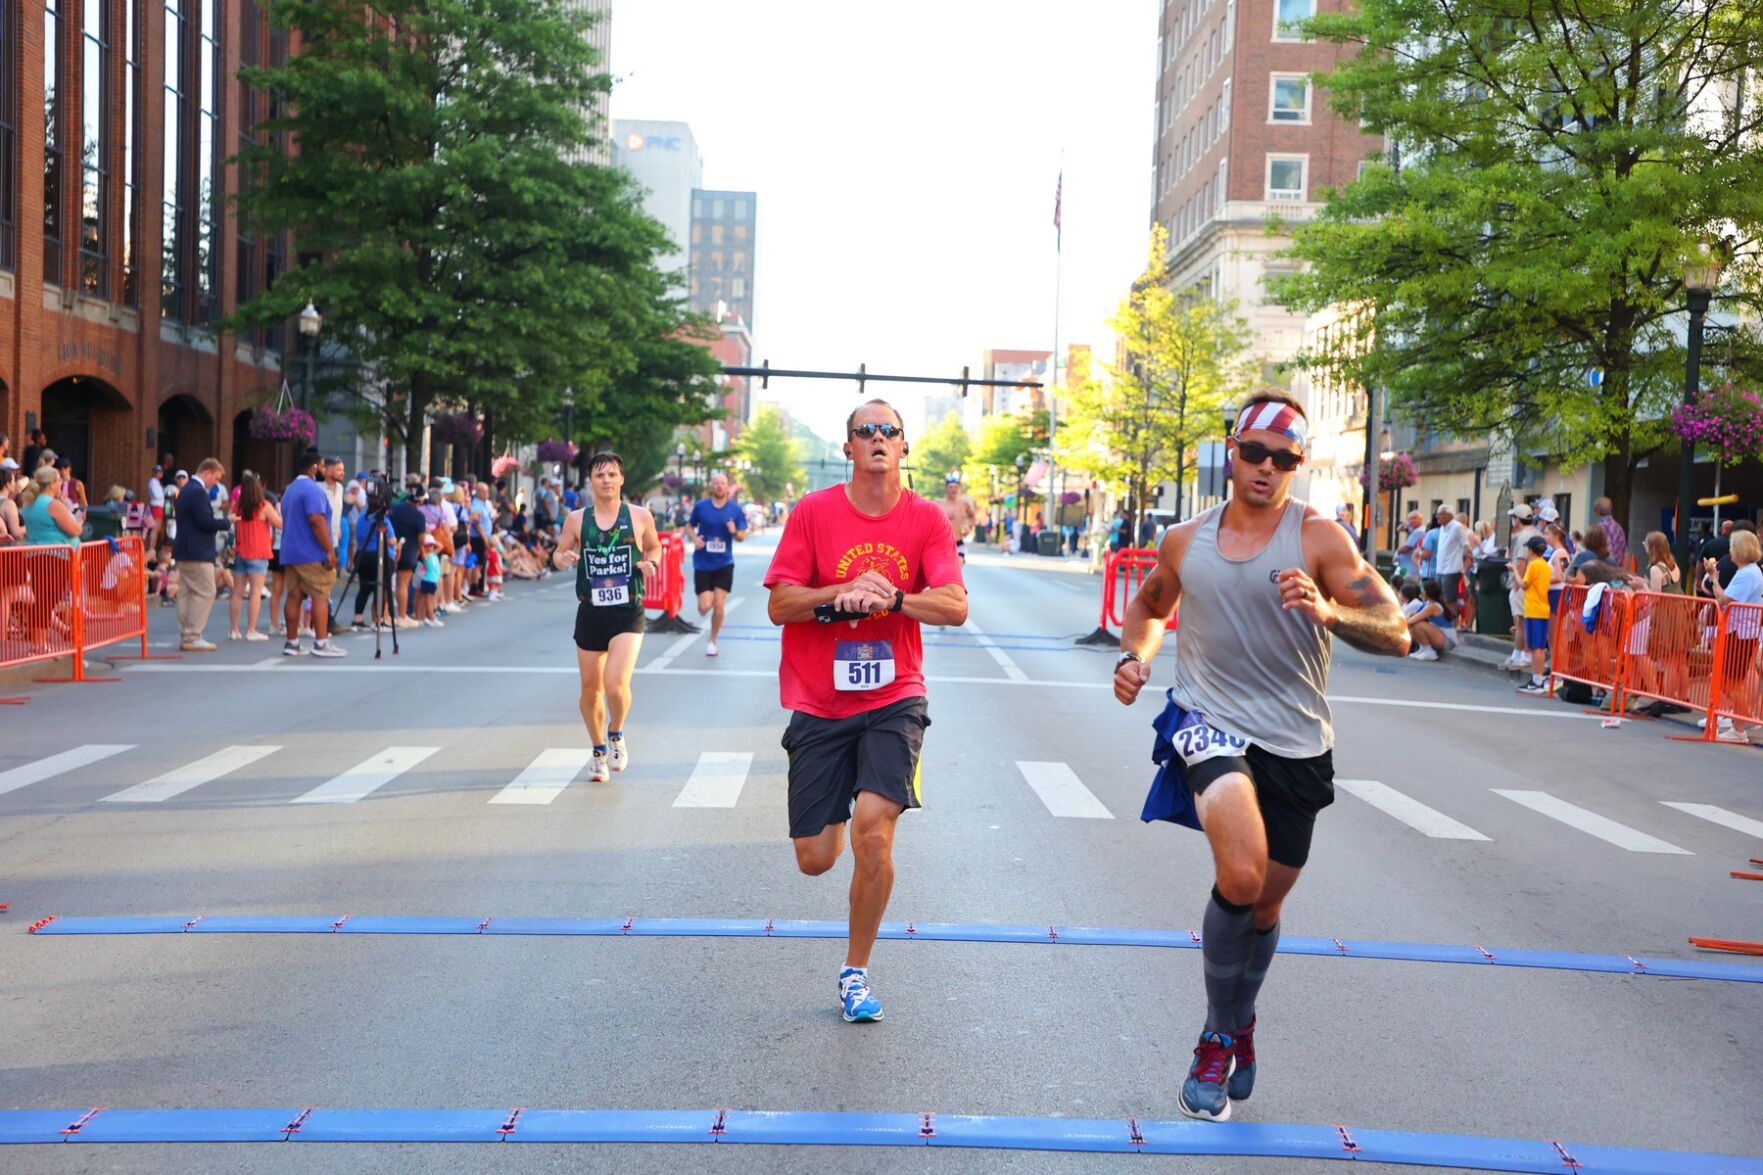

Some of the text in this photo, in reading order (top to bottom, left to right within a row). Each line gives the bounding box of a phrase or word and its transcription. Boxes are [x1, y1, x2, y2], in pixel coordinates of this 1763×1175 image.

[588, 553, 627, 565] Yes for
[835, 543, 909, 580] UNITED STATES
[589, 563, 627, 575] Parks!
[598, 588, 622, 602] 936
[848, 662, 881, 685] 511
